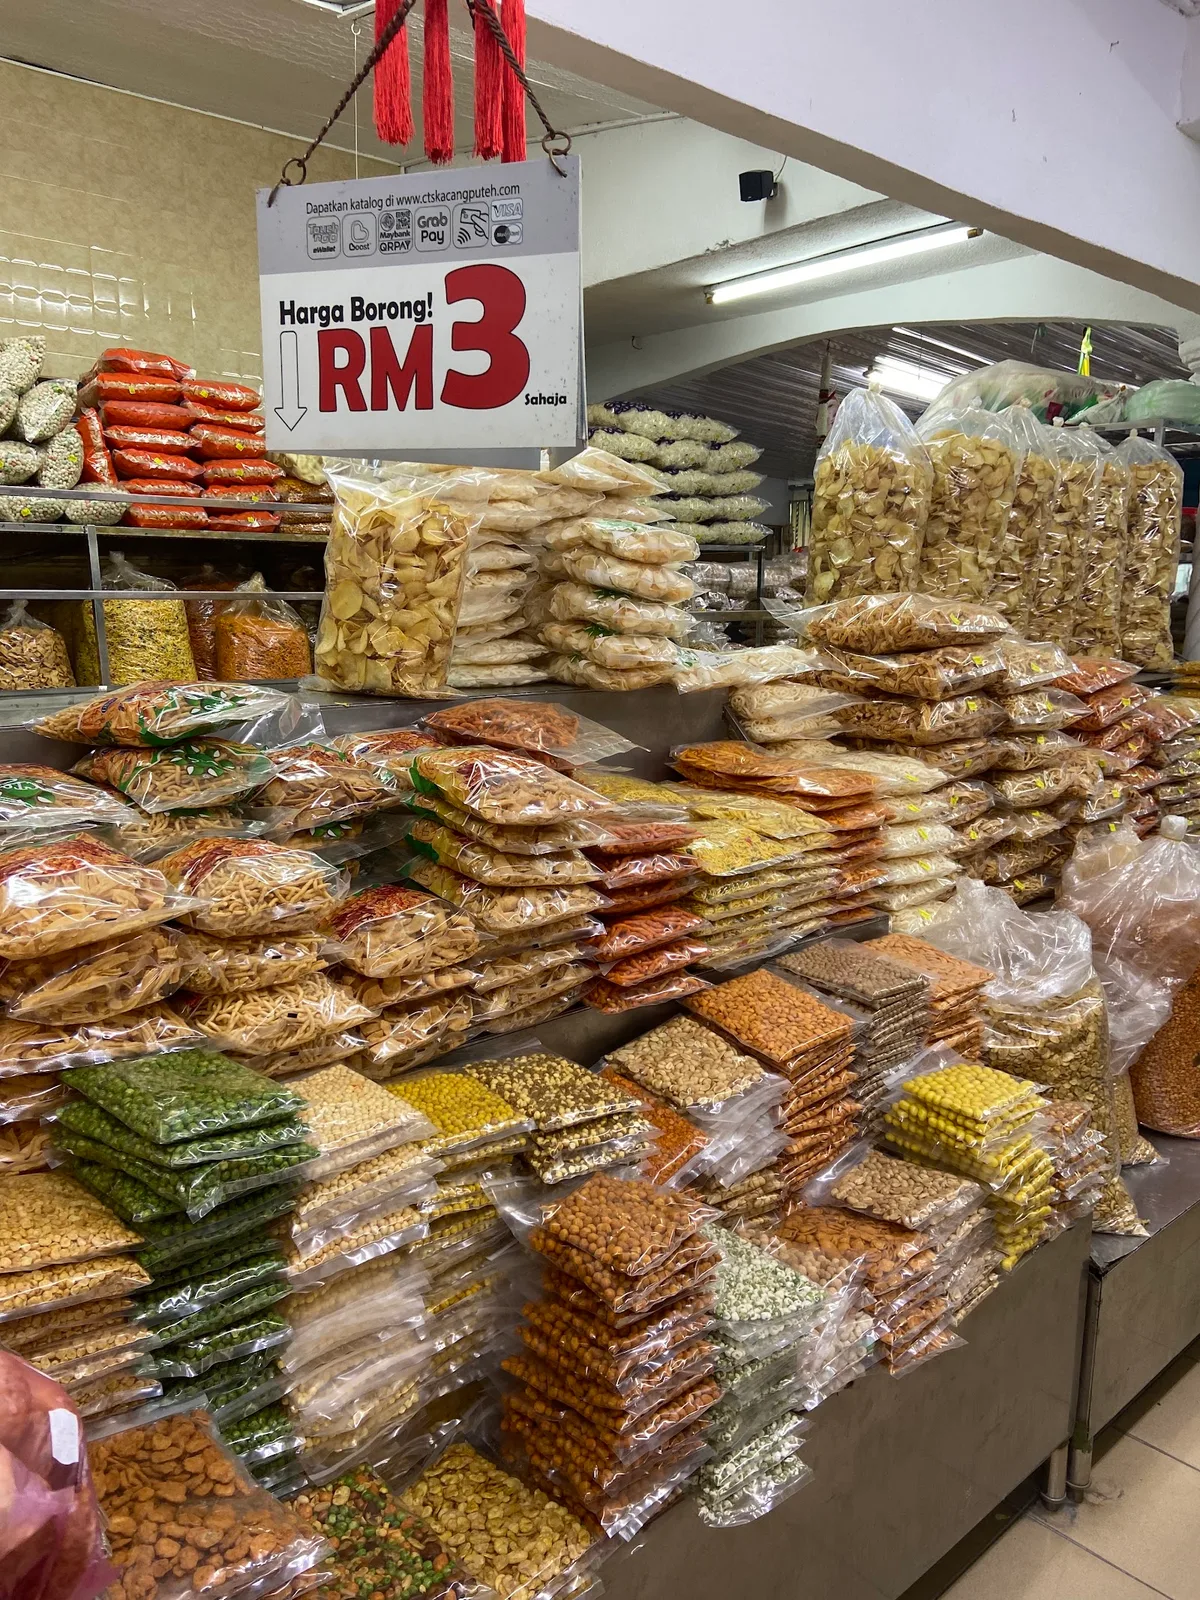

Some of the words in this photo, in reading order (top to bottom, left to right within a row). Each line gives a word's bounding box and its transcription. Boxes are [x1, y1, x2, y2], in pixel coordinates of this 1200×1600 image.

[306, 200, 348, 215] Dapatkan
[350, 196, 384, 211] katalog
[385, 194, 395, 207] di
[396, 184, 520, 205] www.ctskacangputeh.com
[493, 203, 522, 218] VISA
[417, 212, 448, 228] Grab
[380, 230, 411, 239] Maybank
[421, 230, 445, 245] Pay
[379, 240, 411, 252] QRPAY
[279, 300, 344, 328] Harga
[350, 292, 433, 323] Borong!
[524, 393, 568, 407] Sahaja
